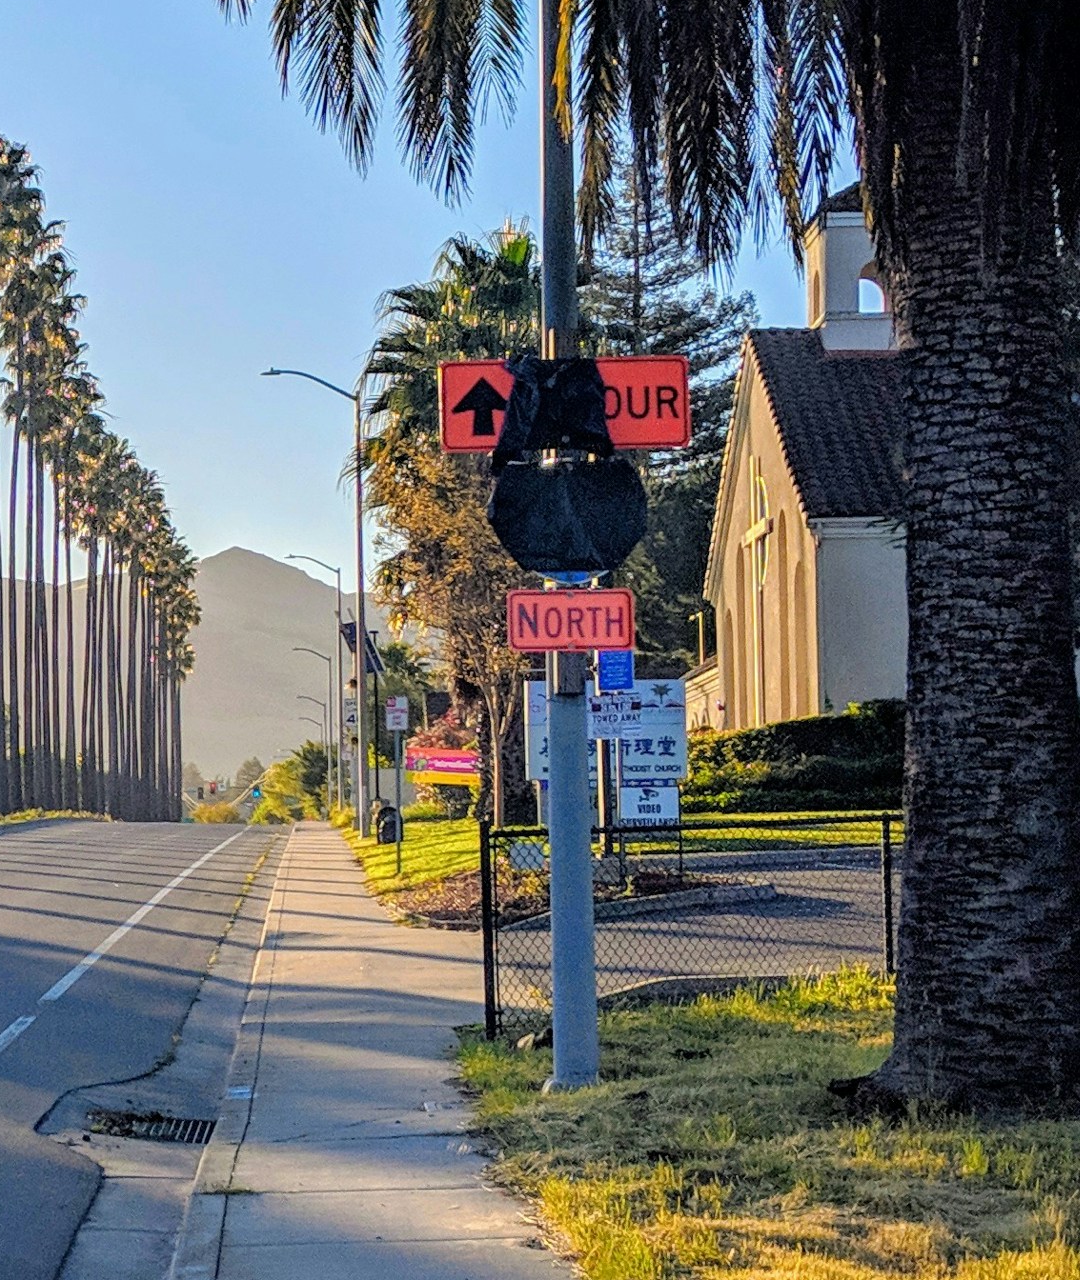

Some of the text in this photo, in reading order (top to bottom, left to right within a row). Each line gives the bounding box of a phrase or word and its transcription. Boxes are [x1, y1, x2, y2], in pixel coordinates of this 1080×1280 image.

[604, 386, 680, 419] OUR
[517, 603, 623, 638] NORTH
[593, 713, 640, 723] TOWED AWAY
[622, 764, 681, 773] THODIST CHURCH
[637, 804, 661, 814] VIDEO
